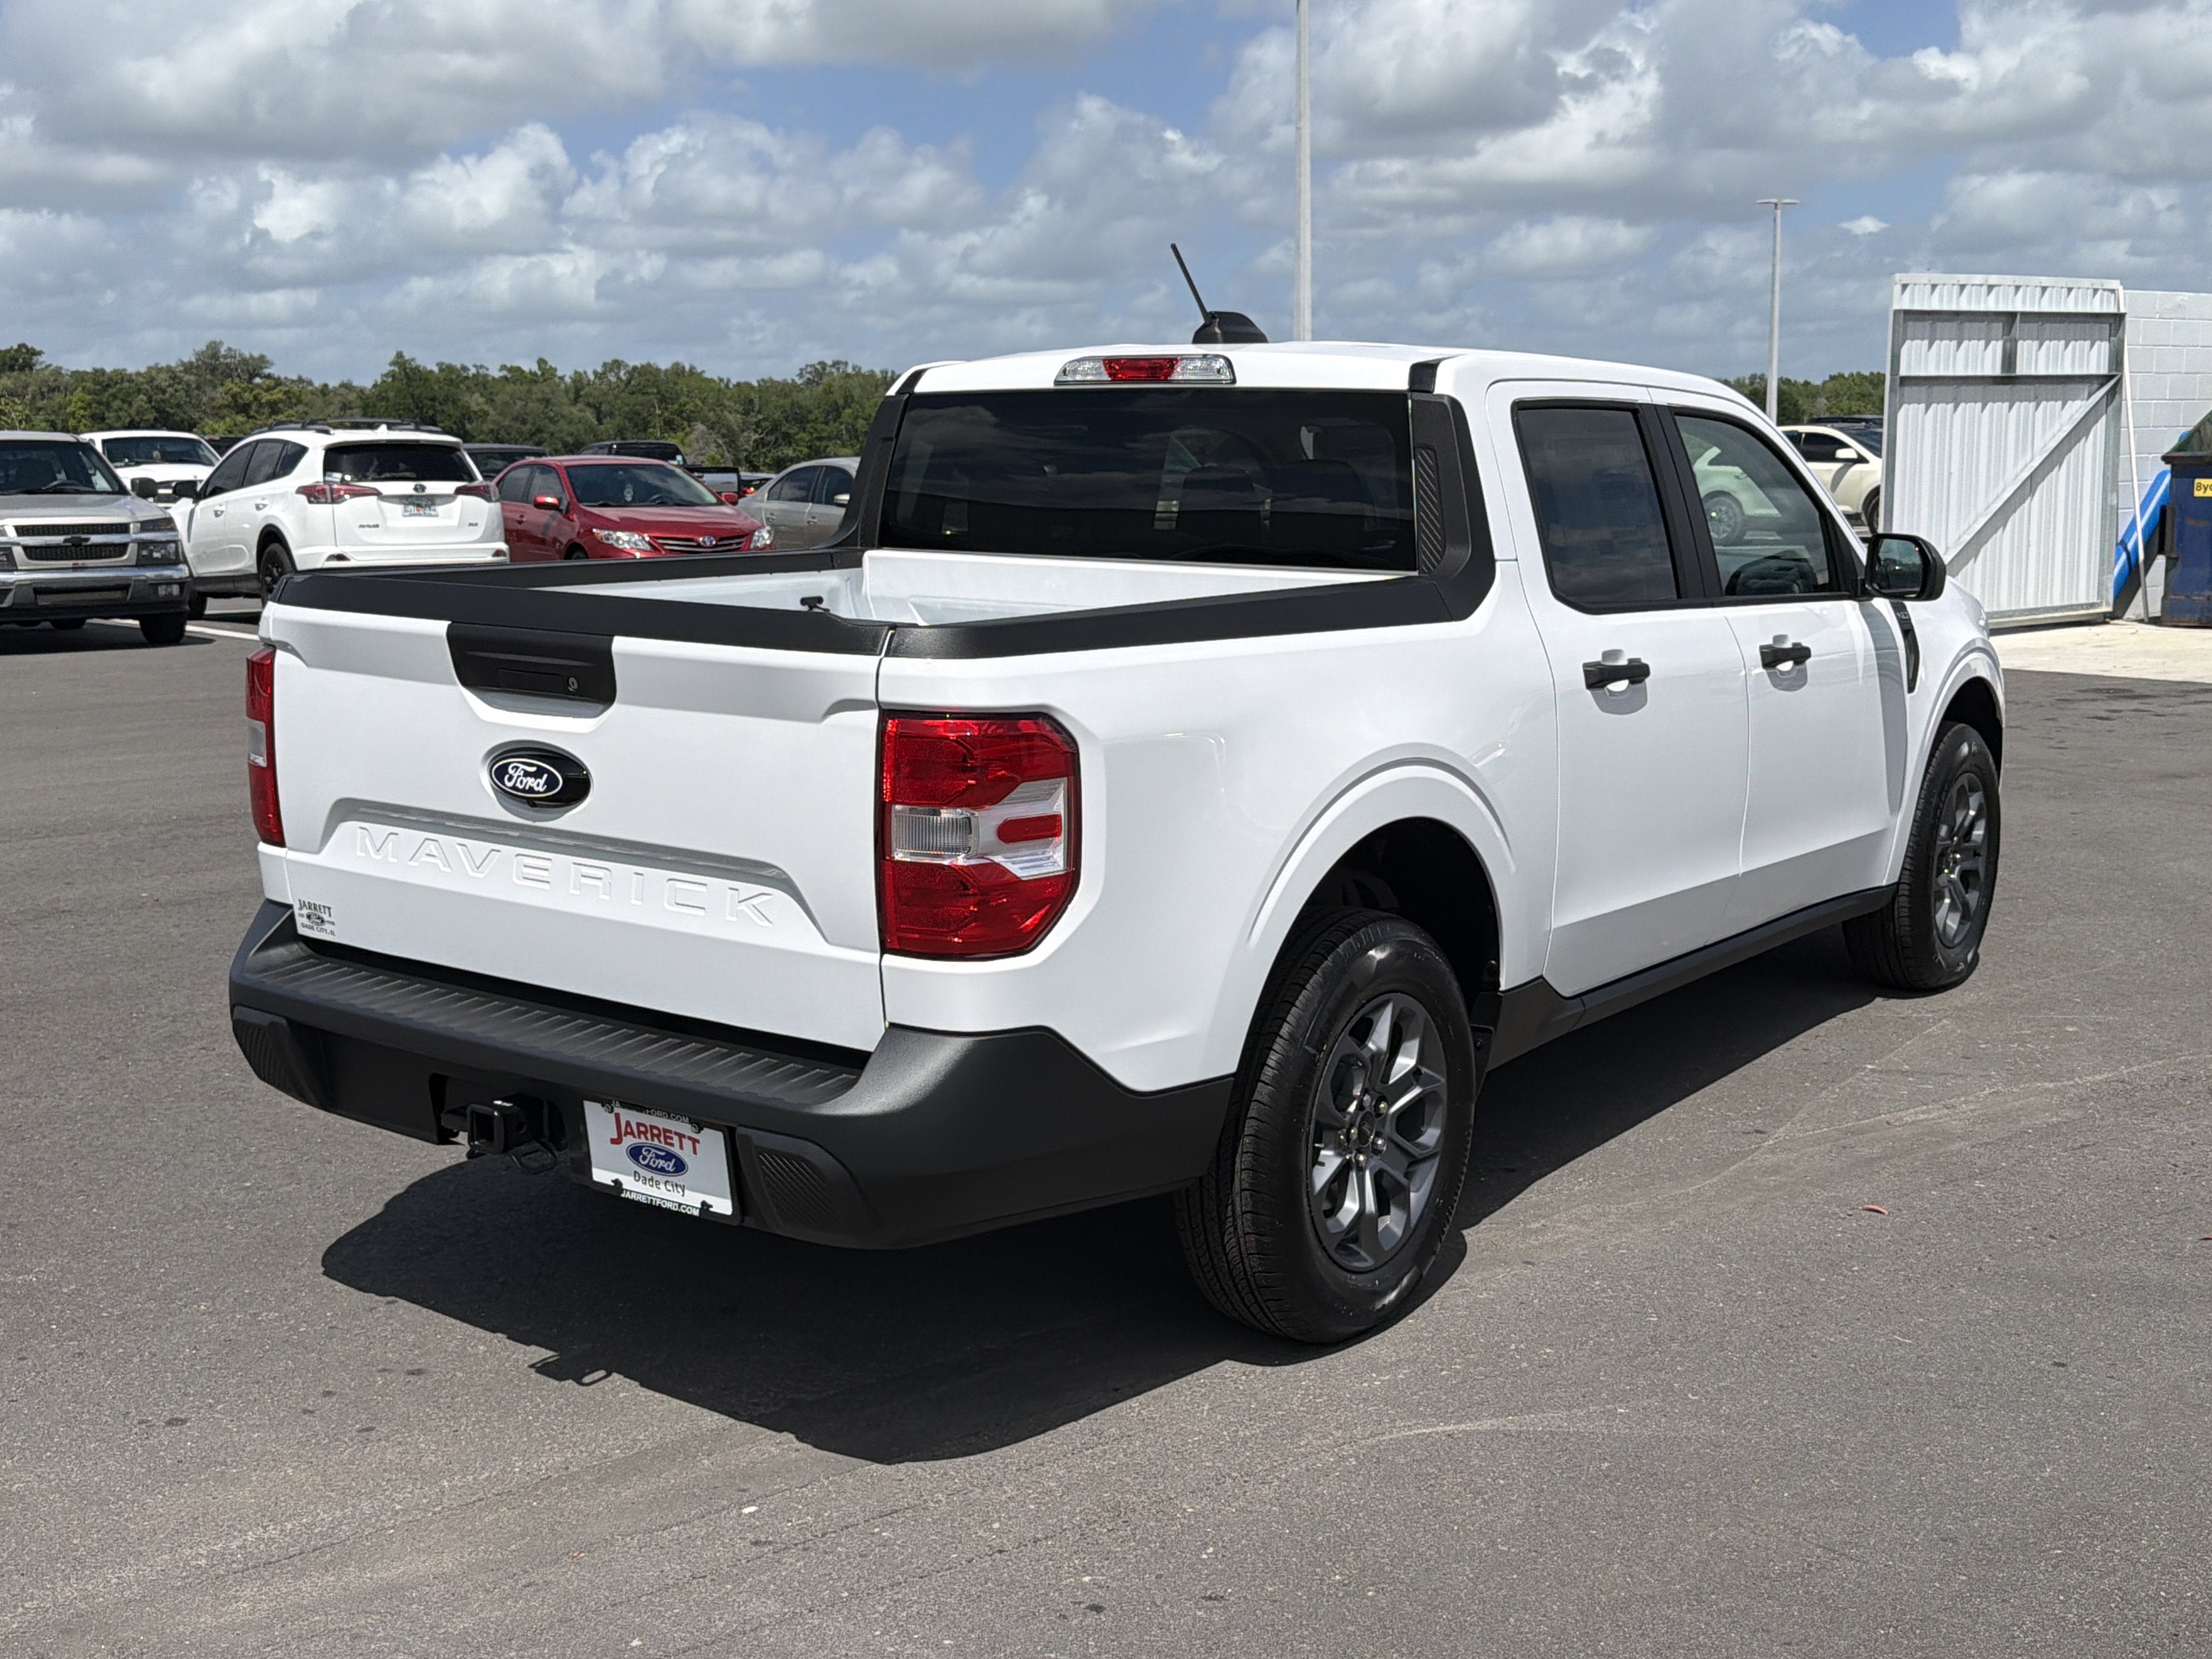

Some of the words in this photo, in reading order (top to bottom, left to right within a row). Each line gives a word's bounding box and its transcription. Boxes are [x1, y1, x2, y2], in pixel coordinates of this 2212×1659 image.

[504, 763, 548, 792] Ford
[356, 826, 775, 928] MAVERICK
[298, 898, 332, 918] JARRETT
[610, 1112, 701, 1155] JARRETT
[639, 1146, 677, 1172] Ford
[633, 1170, 661, 1190] Dade
[664, 1180, 685, 1197] City
[620, 1189, 700, 1217] JARRETTFORD.COM
